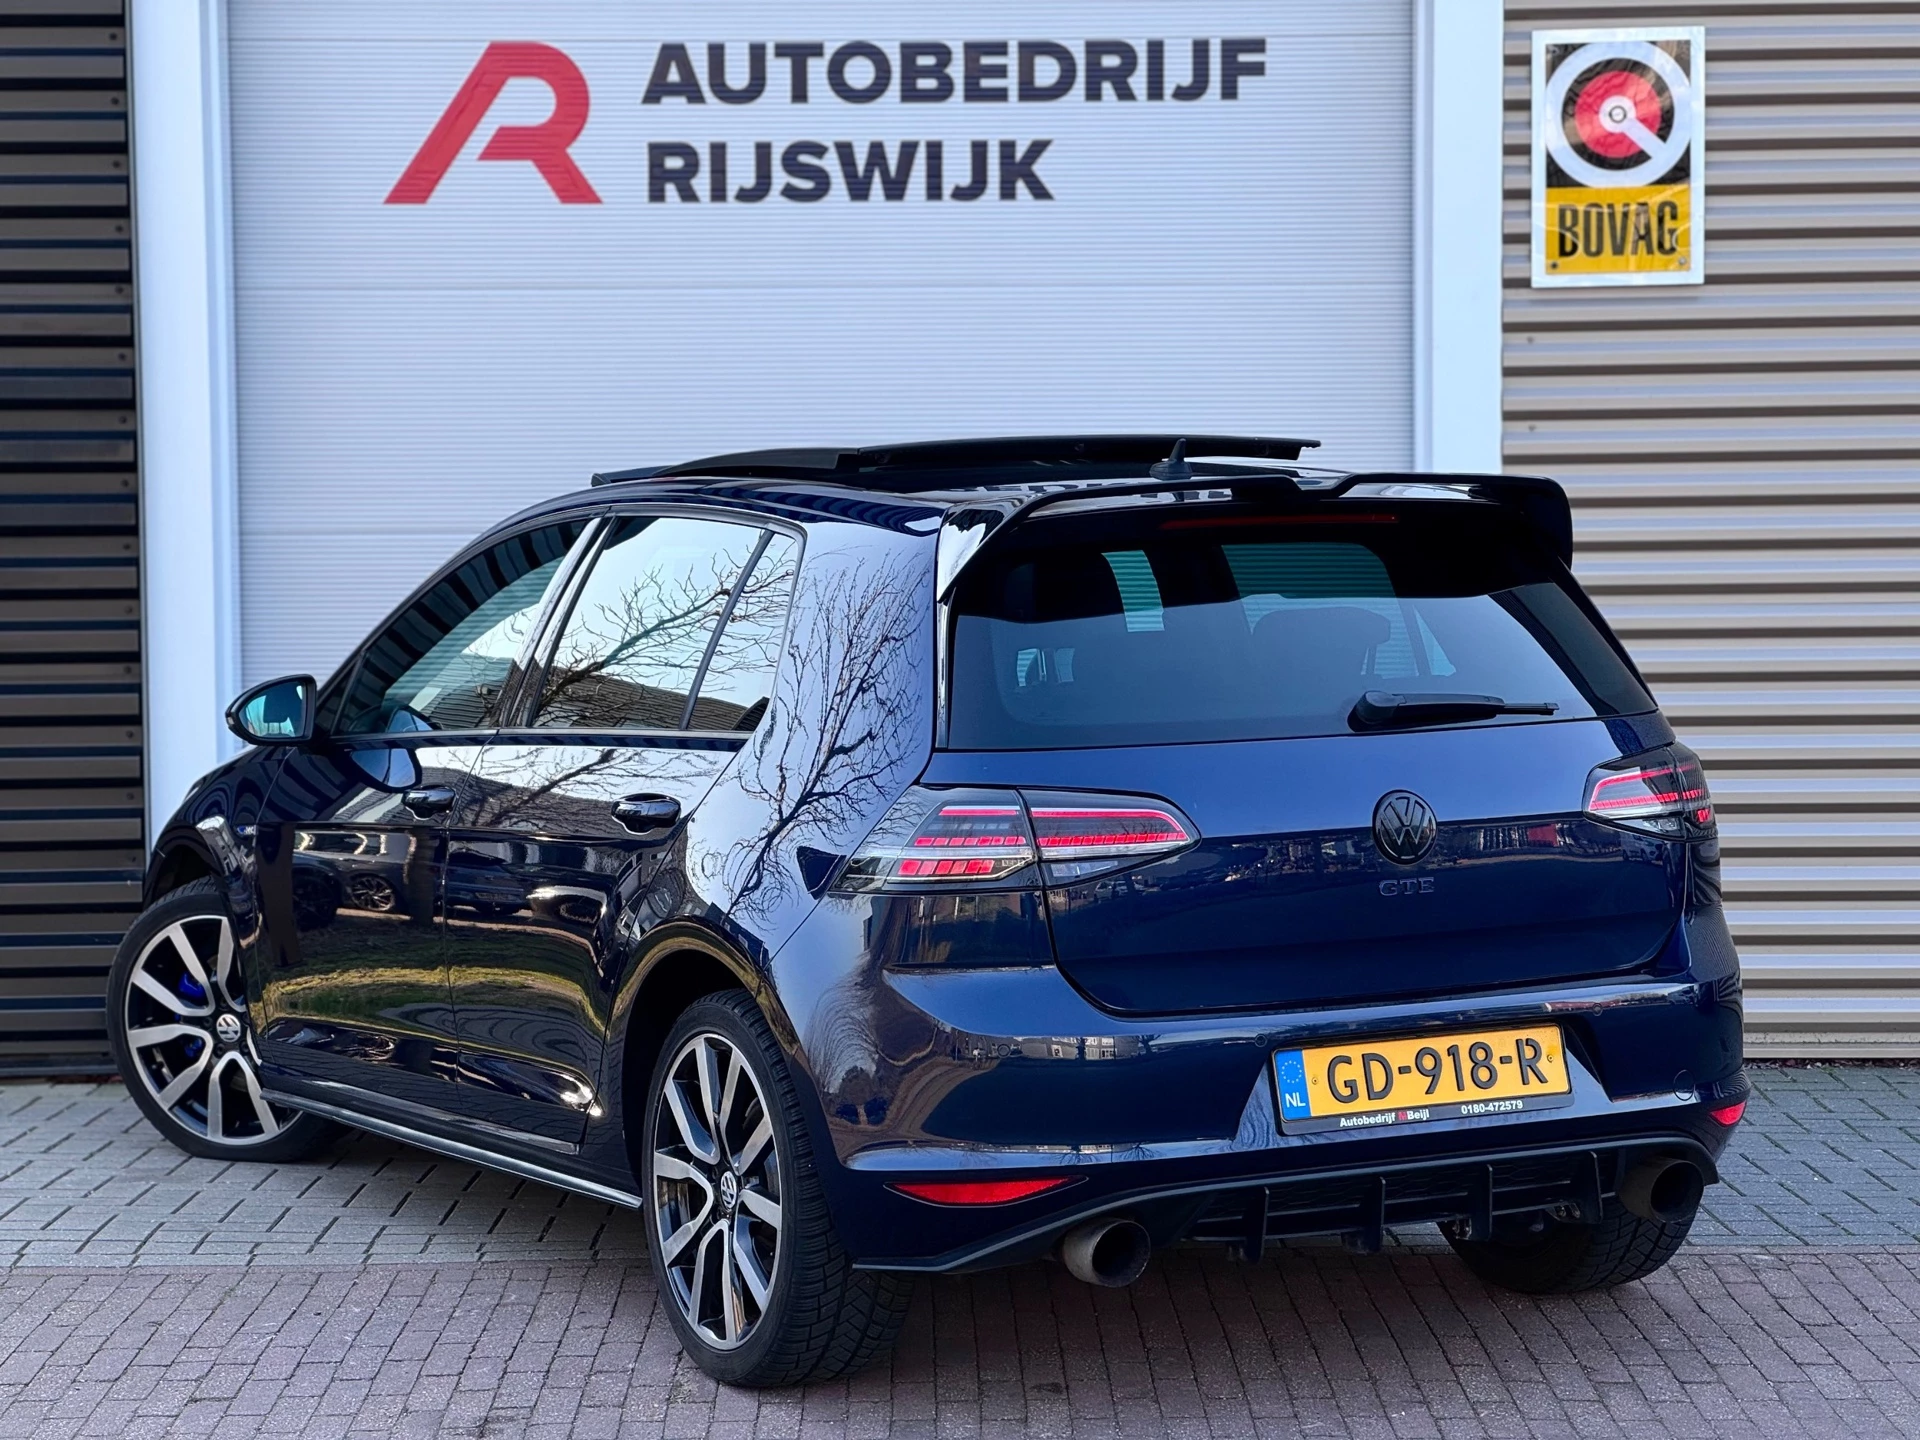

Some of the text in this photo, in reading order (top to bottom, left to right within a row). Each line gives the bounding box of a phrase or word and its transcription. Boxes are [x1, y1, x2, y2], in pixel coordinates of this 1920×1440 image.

[641, 38, 1267, 105] AUTOBEDRIJF
[647, 139, 1055, 202] RIJSWIJK
[1557, 200, 1679, 257] BOVAG
[1379, 876, 1435, 896] GTE
[1326, 1037, 1549, 1103] GD-918-R
[1285, 1092, 1306, 1108] NL
[1461, 1100, 1523, 1115] 0180-472579
[1339, 1113, 1396, 1127] Autobedrijf
